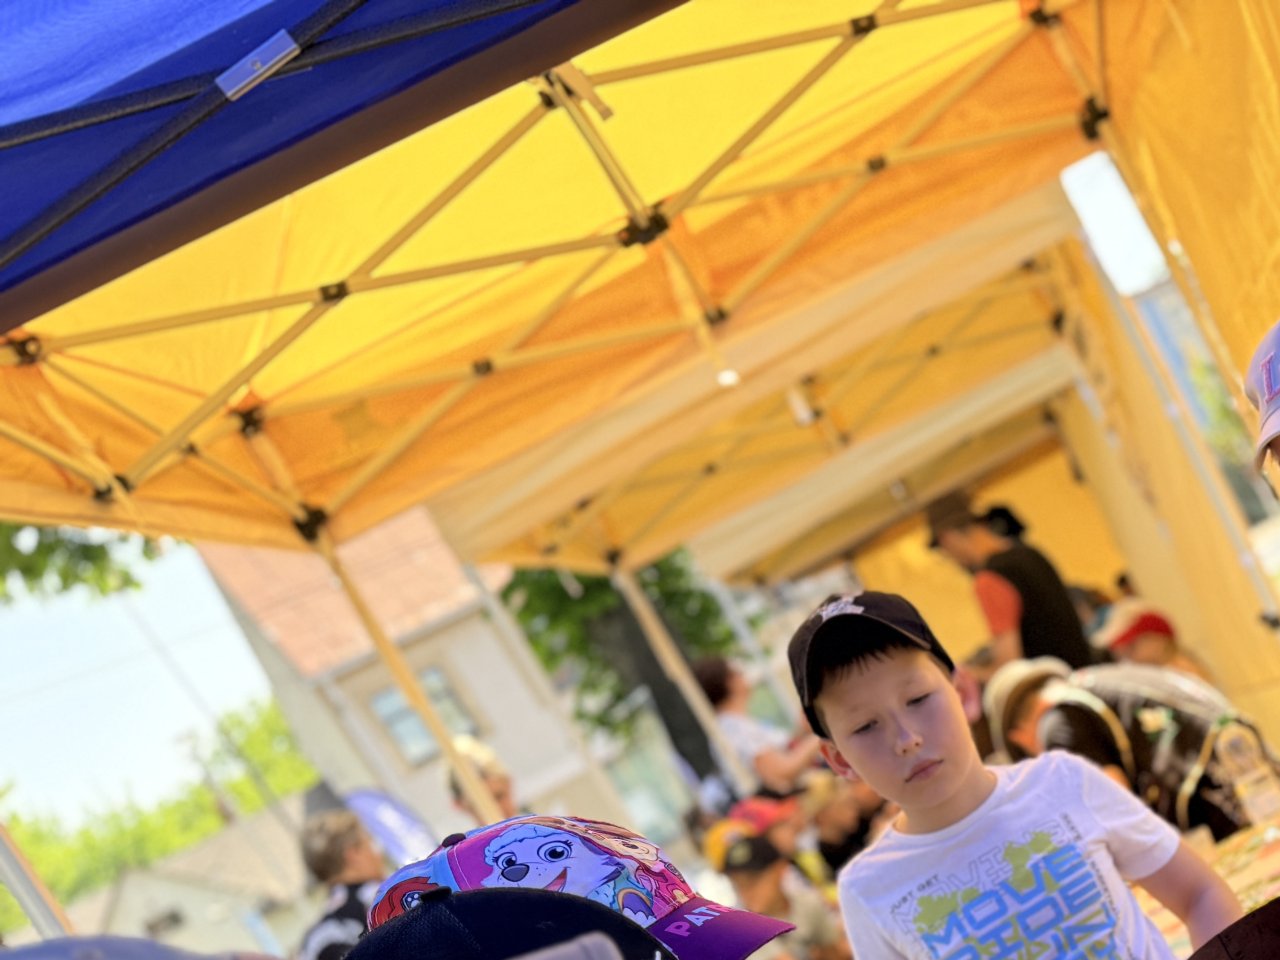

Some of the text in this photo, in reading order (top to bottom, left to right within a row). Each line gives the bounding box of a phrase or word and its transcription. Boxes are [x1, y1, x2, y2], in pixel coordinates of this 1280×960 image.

[890, 873, 941, 914] JUST GET
[920, 842, 1083, 960] MOVE
